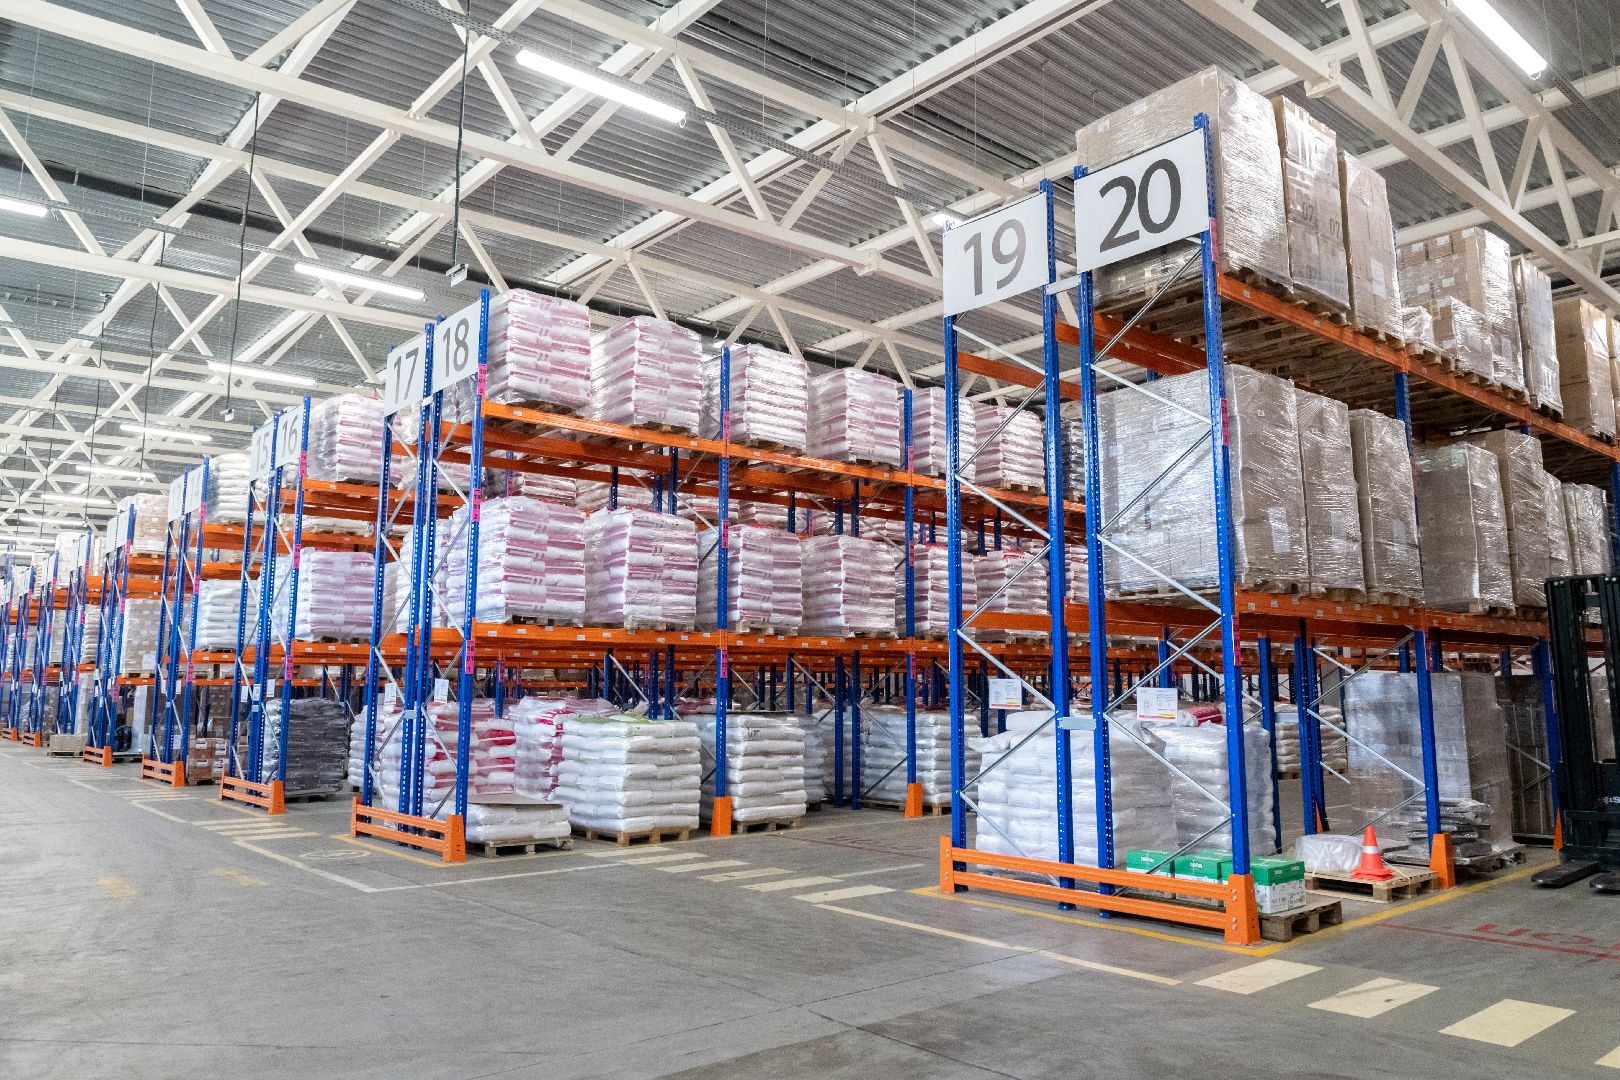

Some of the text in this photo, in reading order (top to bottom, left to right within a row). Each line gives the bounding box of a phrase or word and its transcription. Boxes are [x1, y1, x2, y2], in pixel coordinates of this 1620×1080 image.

[1098, 158, 1182, 253] 20
[963, 218, 1027, 297] 19
[393, 347, 419, 404] 17
[442, 317, 470, 378] 18
[256, 431, 270, 473] 15
[282, 414, 299, 458] 16
